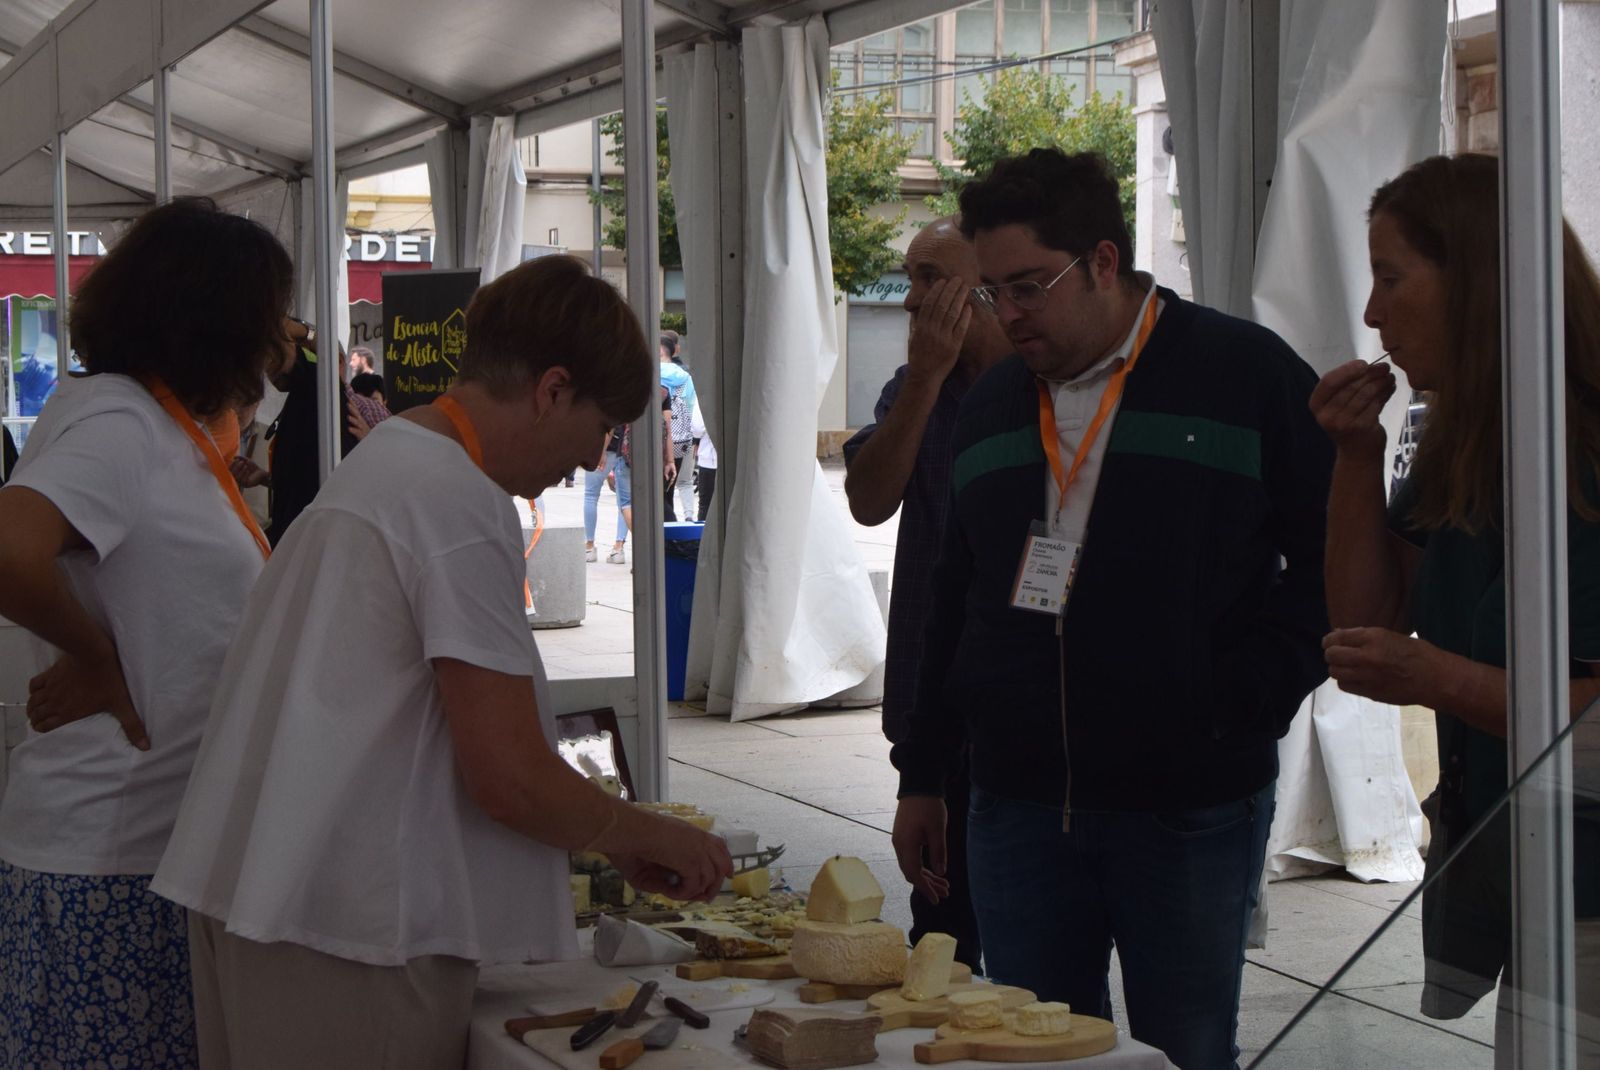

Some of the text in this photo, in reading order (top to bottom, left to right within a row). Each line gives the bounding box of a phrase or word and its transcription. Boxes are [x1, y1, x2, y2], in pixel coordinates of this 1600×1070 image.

[0, 231, 109, 256] RET
[393, 315, 440, 341] Esencia
[387, 343, 399, 361] de
[402, 341, 441, 367] Aliste
